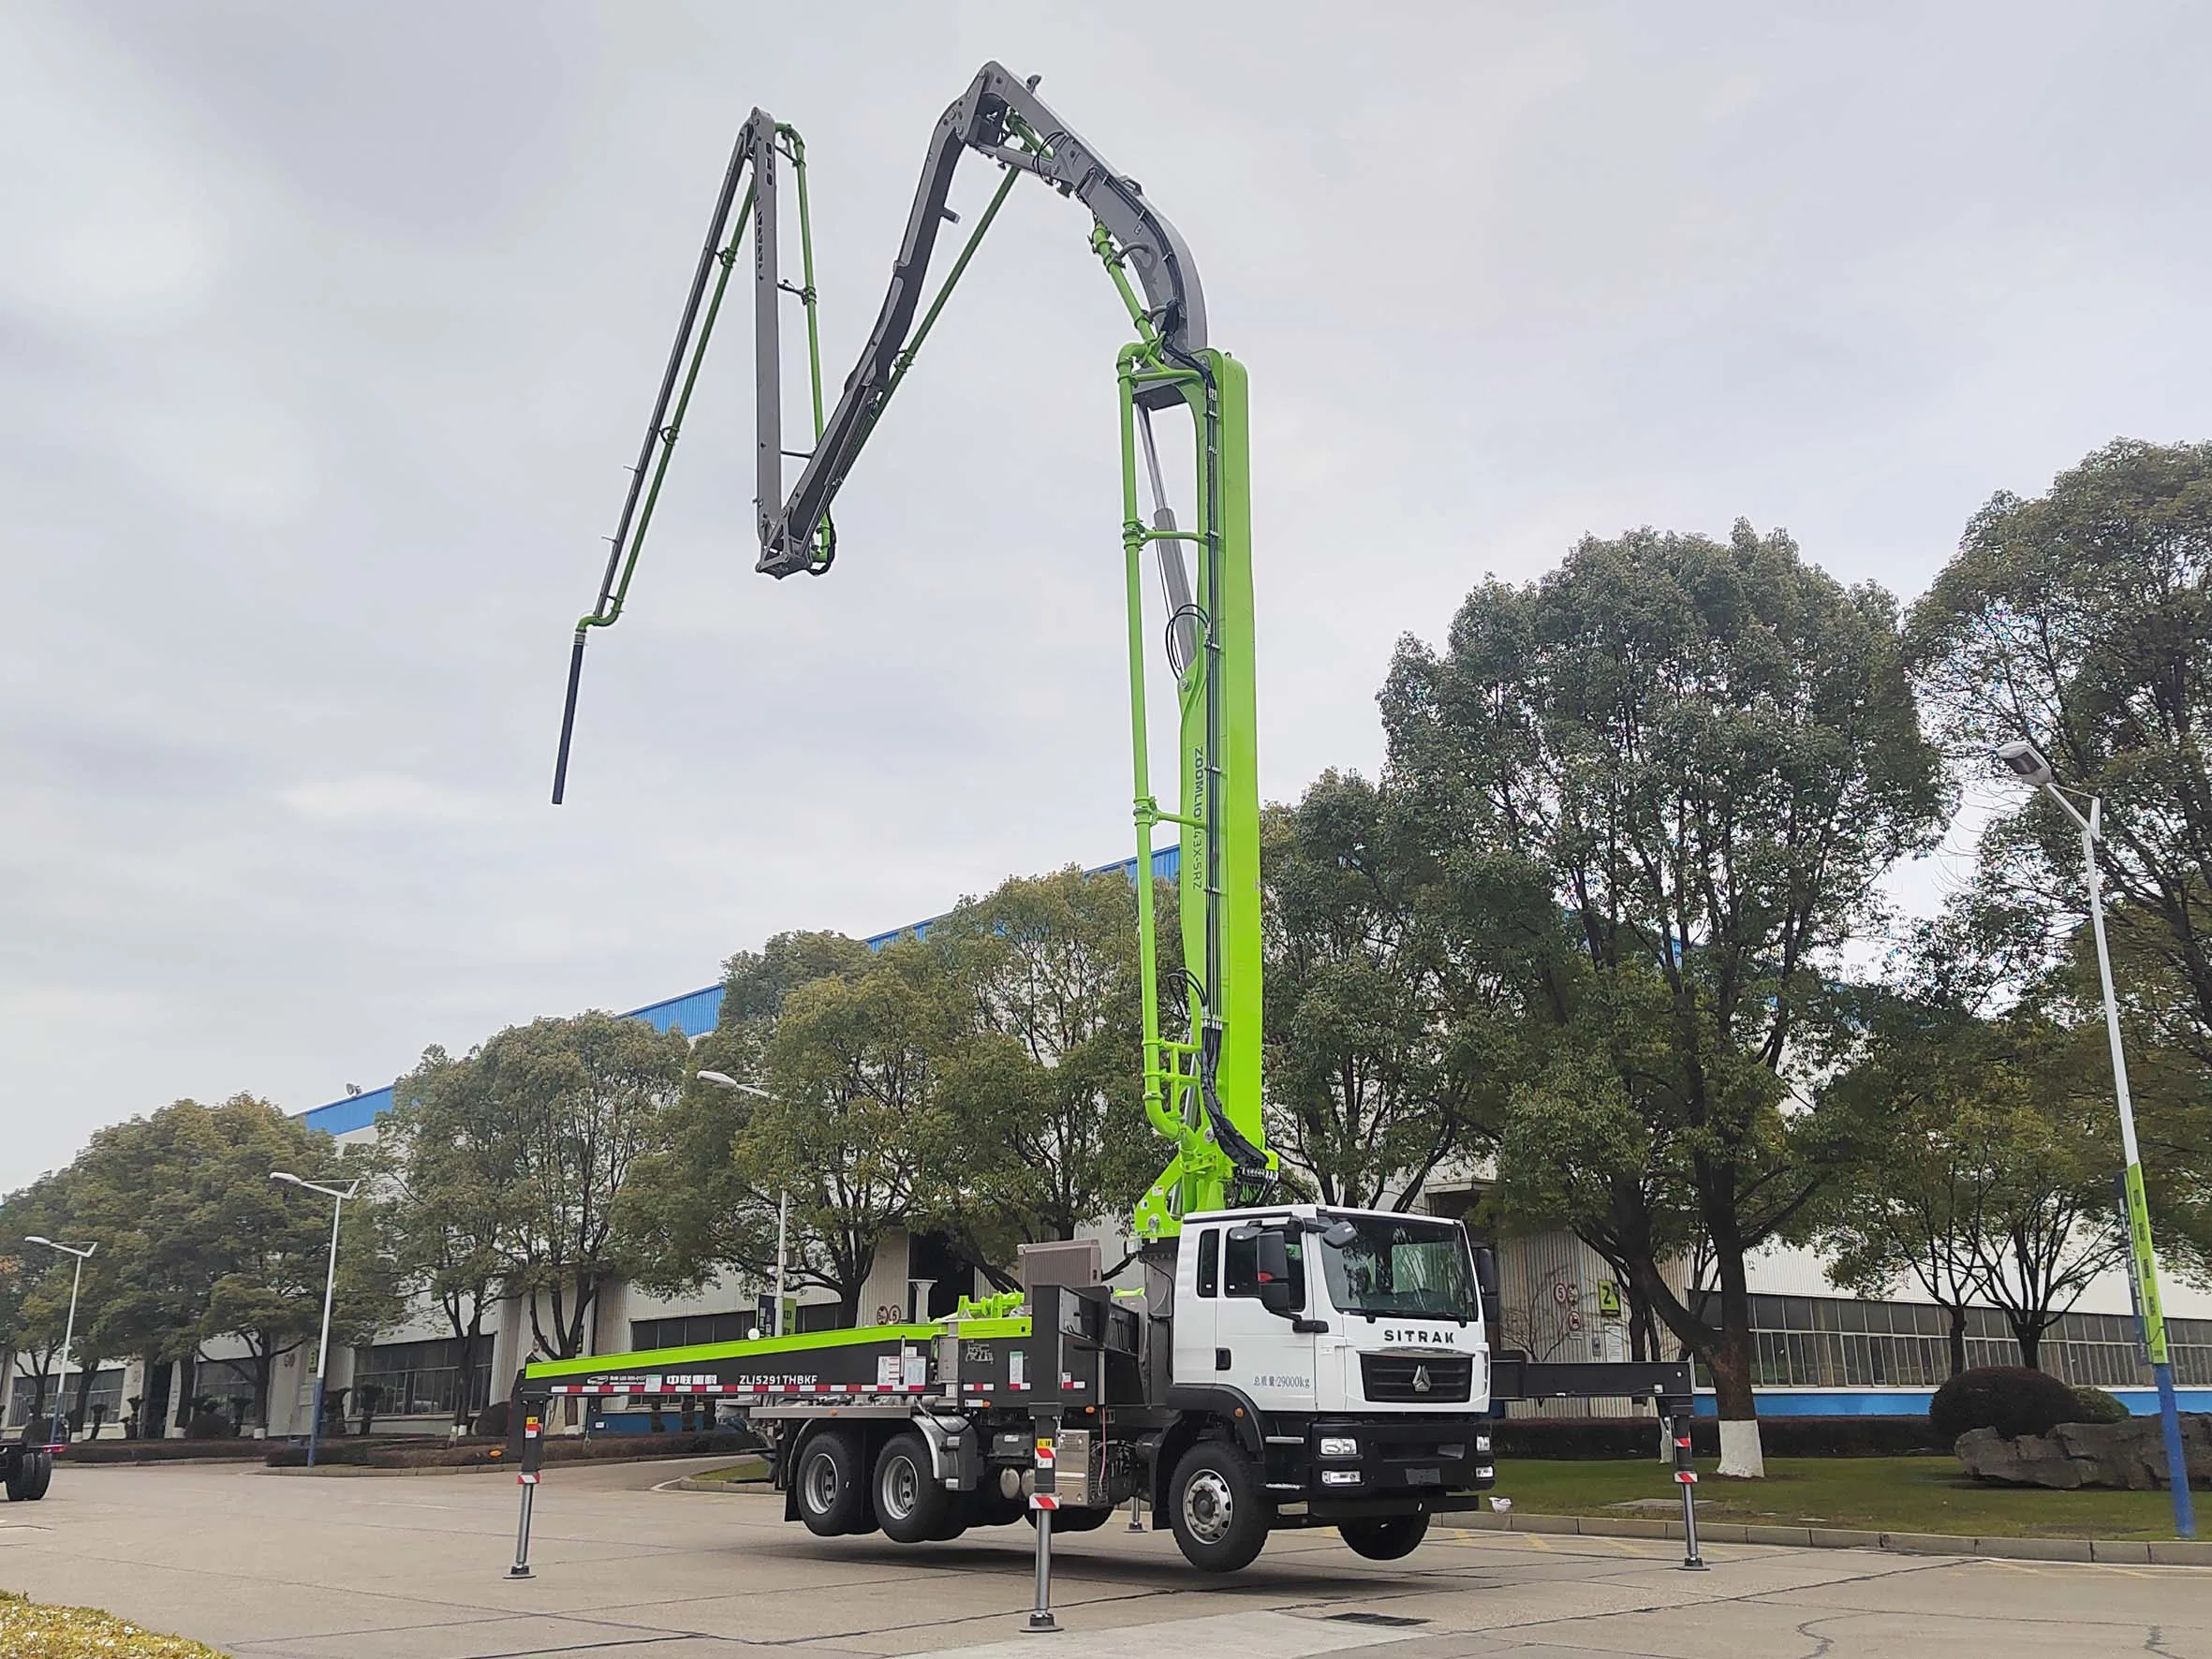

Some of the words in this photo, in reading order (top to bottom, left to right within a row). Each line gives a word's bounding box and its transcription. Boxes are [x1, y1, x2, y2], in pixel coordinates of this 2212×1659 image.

[1193, 747, 1203, 826] ZOOMLIO
[1602, 1285, 1612, 1304] 2
[1384, 1329, 1454, 1343] SITRAK
[739, 1374, 818, 1386] ZLJ5291THBKF
